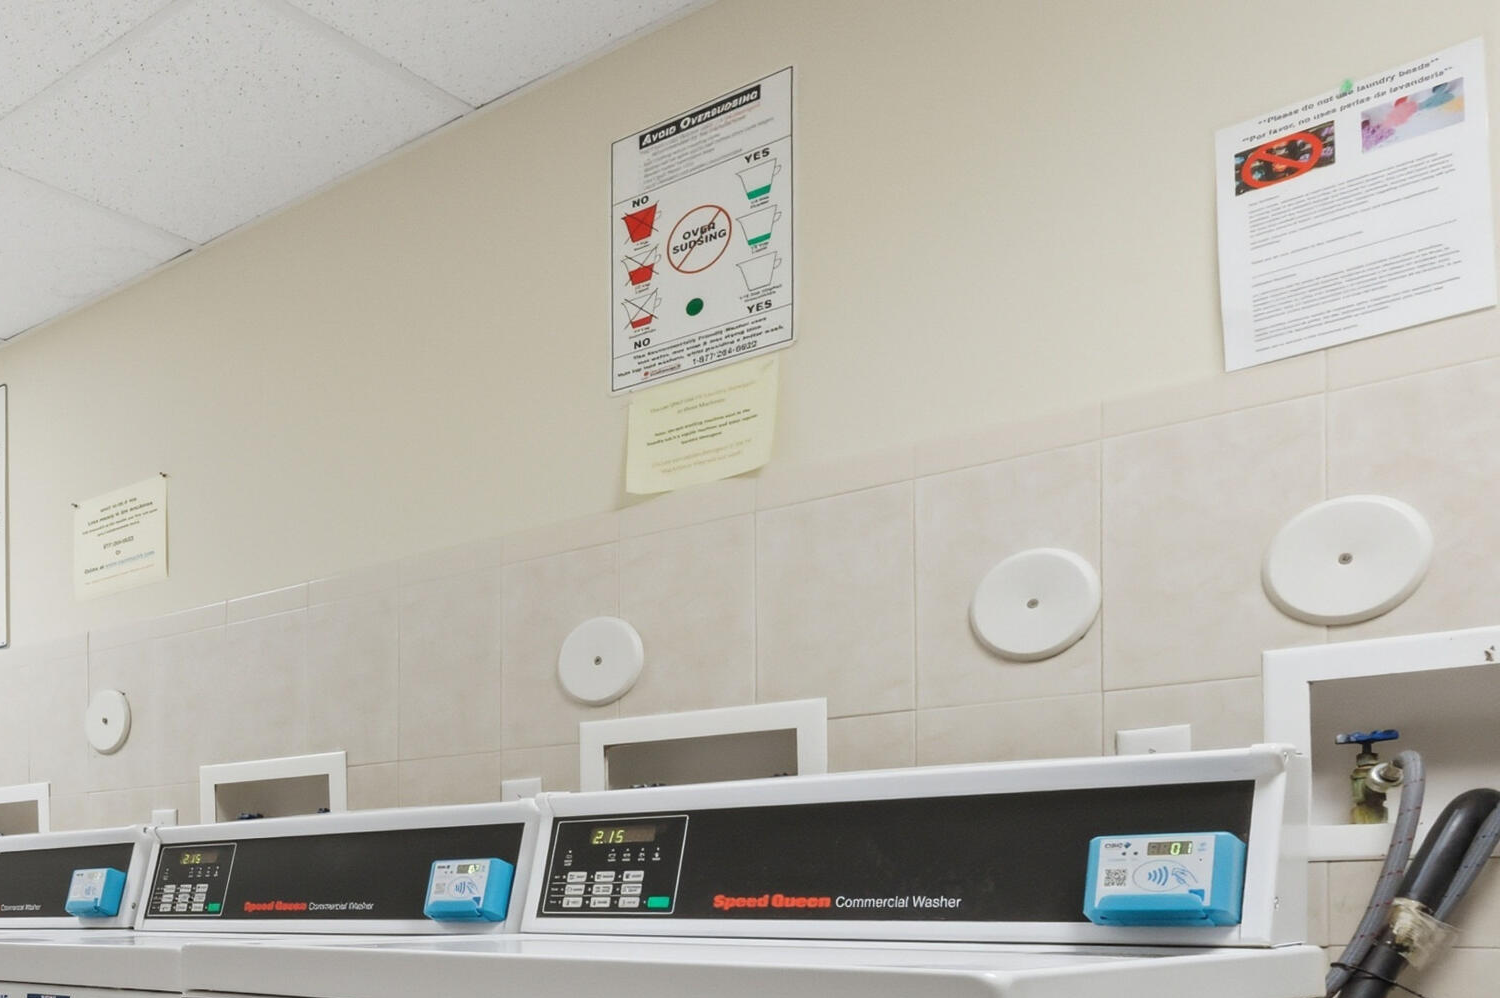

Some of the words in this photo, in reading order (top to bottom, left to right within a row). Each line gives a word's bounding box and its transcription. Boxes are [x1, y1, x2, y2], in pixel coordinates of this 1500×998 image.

[1301, 103, 1314, 111] do
[1356, 74, 1395, 92] laundry
[744, 147, 771, 164] YES
[632, 195, 650, 208] NO
[682, 222, 716, 240] OVER
[672, 229, 727, 255] SUDSING
[746, 299, 772, 314] YES
[633, 337, 651, 349] NO
[713, 893, 769, 911] Speed
[771, 894, 831, 908] Queen
[835, 895, 908, 908] Commercial
[912, 896, 962, 908] Washer
